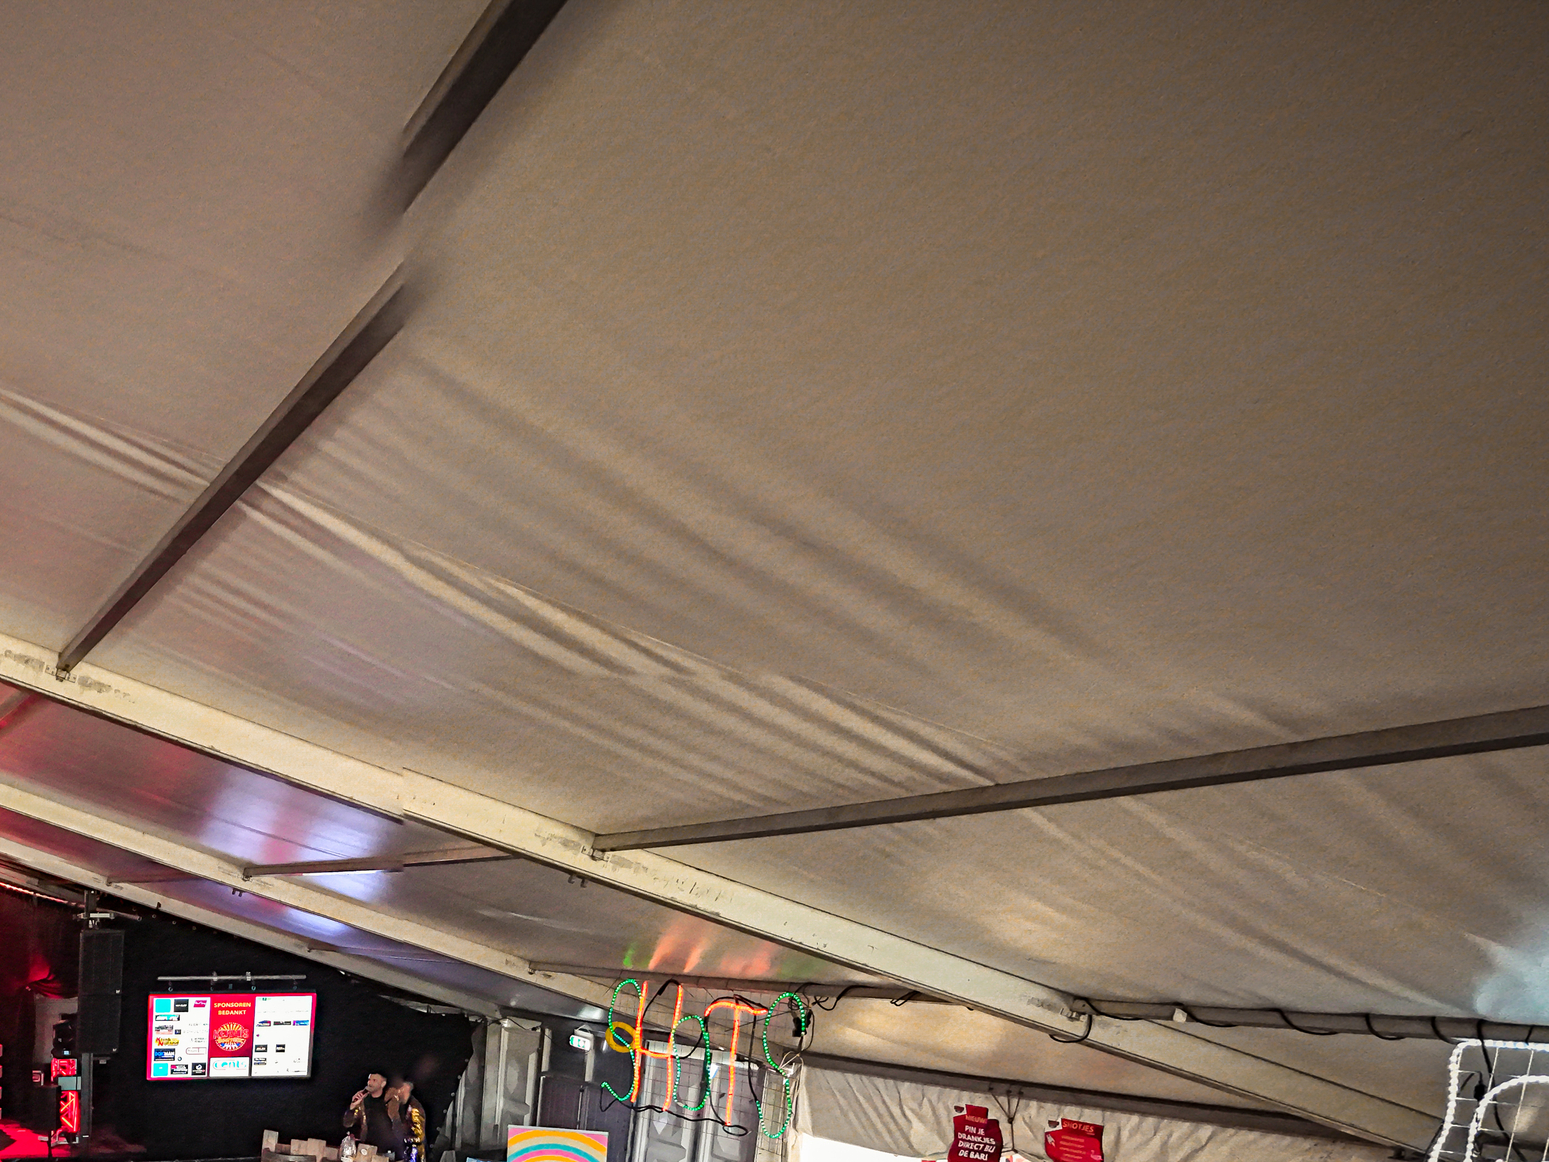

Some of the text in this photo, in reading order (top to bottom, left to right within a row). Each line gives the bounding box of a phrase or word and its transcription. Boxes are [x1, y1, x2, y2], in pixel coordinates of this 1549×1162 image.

[601, 978, 807, 1140] SHOTS
[964, 1125, 985, 1136] PIN JE
[1062, 1120, 1095, 1133] SHOTJES
[957, 1132, 996, 1145] DRANKJES
[958, 1140, 983, 1151] DIRECT
[958, 1149, 988, 1161] DE BAR!
